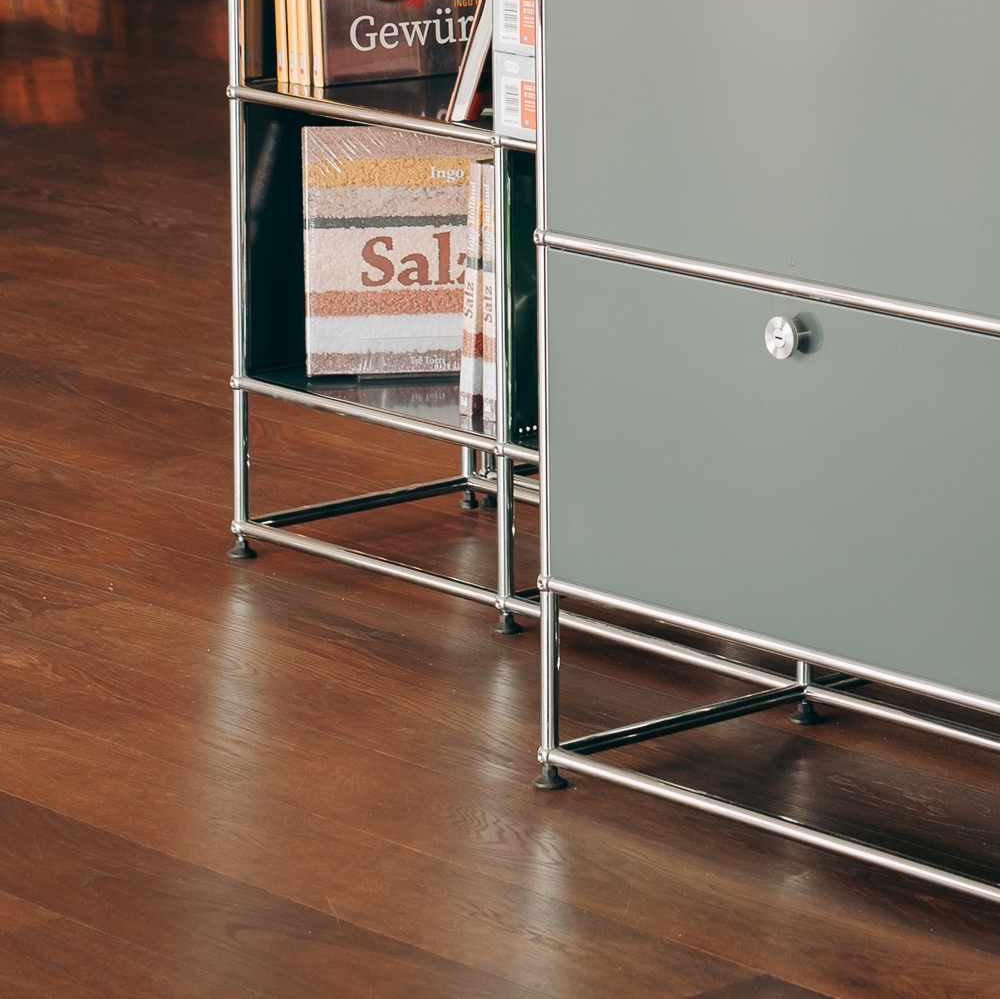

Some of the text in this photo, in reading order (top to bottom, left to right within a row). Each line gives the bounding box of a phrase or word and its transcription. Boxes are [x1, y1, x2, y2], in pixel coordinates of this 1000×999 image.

[454, 0, 473, 7] INGO
[430, 166, 464, 182] Ingo
[467, 182, 476, 226] Holland
[482, 184, 490, 228] Holland
[464, 282, 474, 319] Salz
[484, 285, 492, 322] Salz
